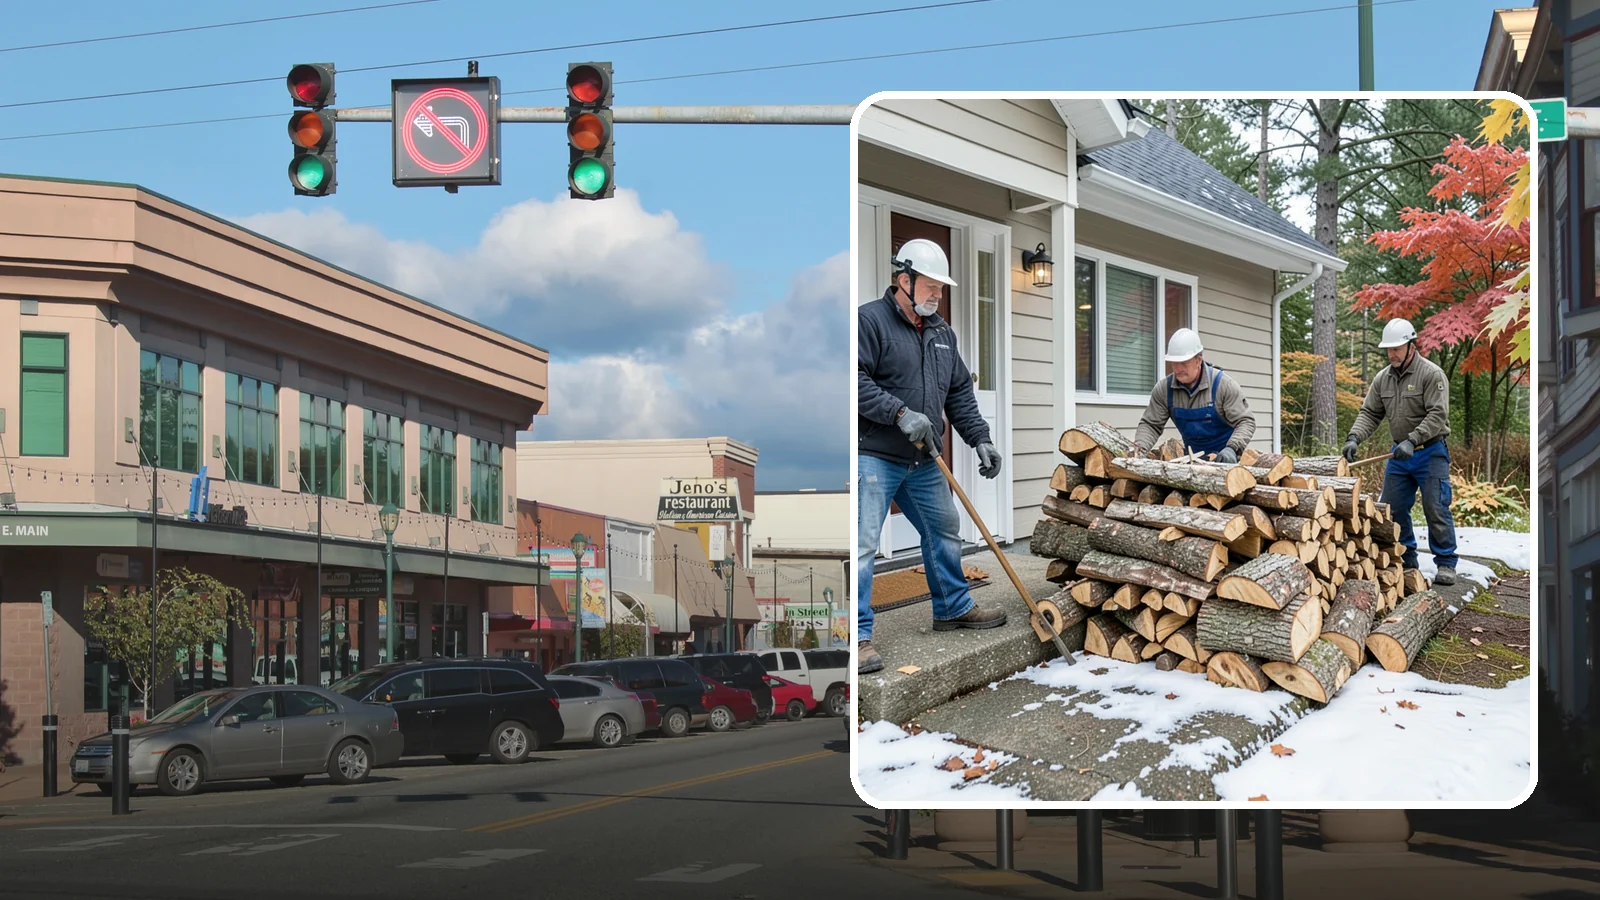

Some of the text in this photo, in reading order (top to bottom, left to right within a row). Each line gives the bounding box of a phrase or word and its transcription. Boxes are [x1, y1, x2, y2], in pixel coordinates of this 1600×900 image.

[669, 480, 728, 495] Jeno's
[665, 496, 731, 509] restaurant
[658, 510, 682, 519] Italian
[686, 509, 714, 519] American
[714, 509, 738, 519] Cuisine
[2, 525, 49, 536] E. MAIN
[797, 607, 829, 617] Street
